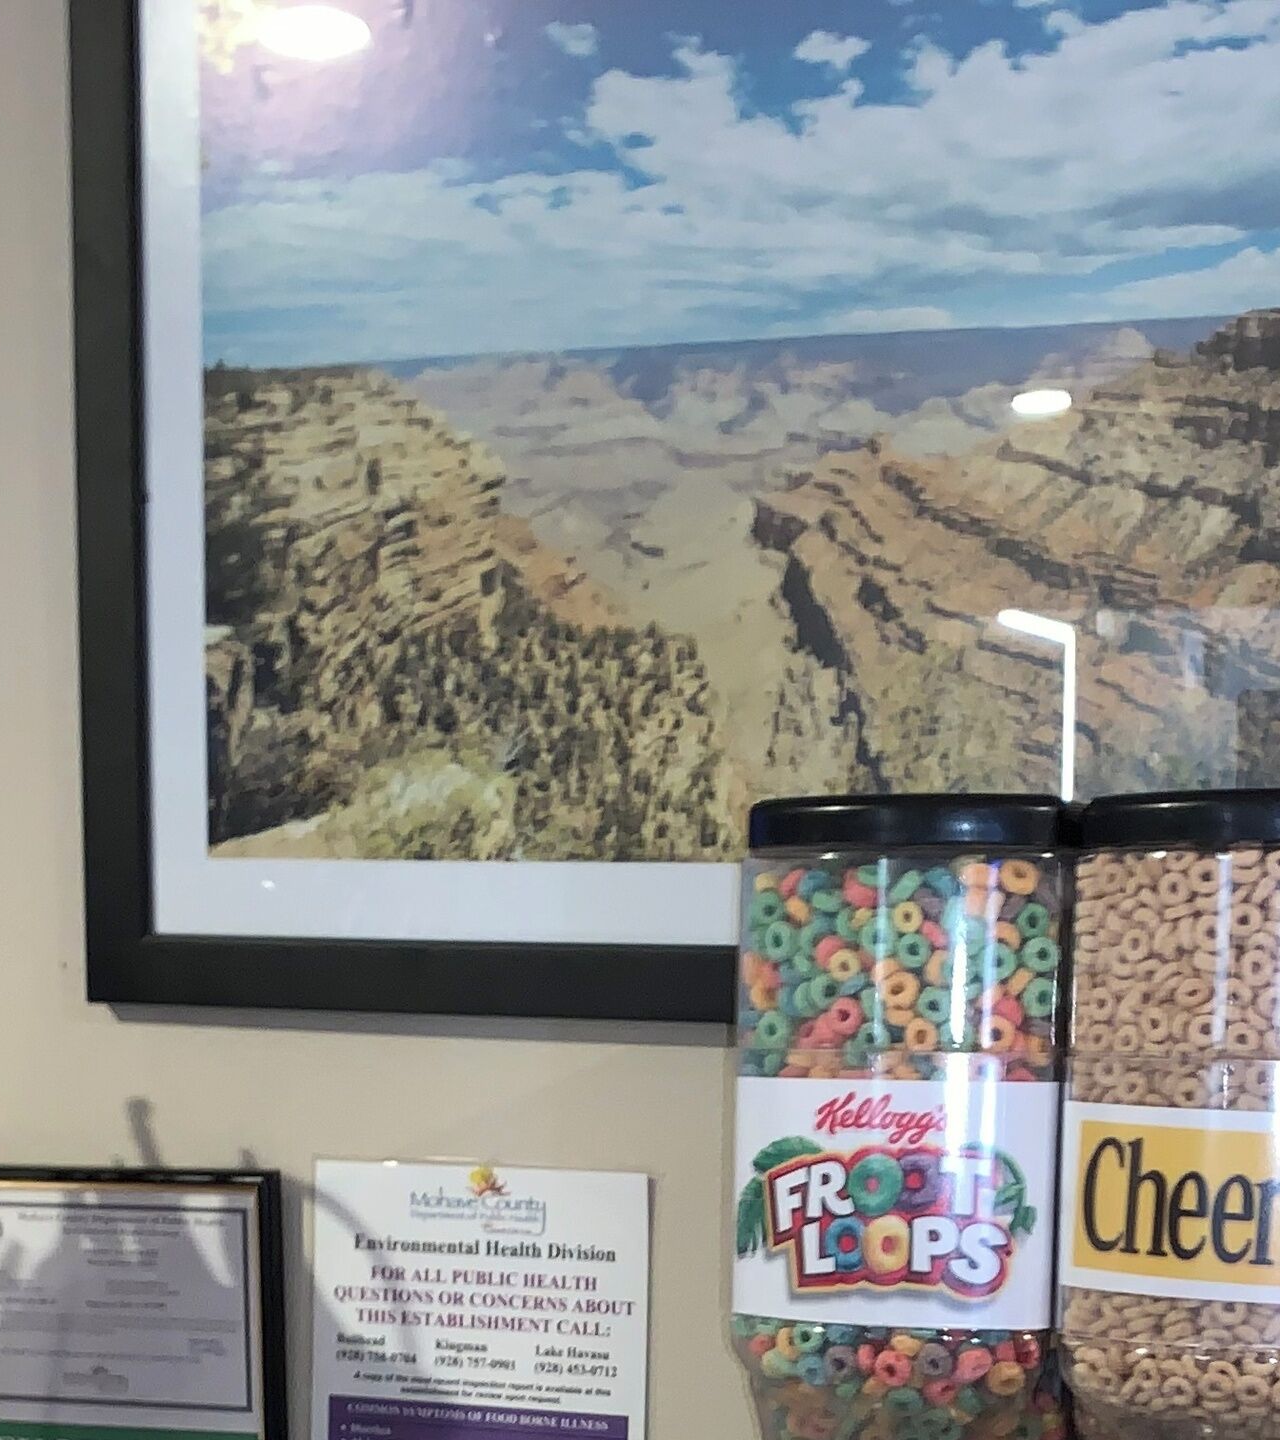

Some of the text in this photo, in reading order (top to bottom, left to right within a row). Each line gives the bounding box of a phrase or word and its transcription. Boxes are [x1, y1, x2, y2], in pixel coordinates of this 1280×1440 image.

[773, 1152, 993, 1234] FROOT
[354, 1233, 616, 1262] Environmental Health Division
[801, 1213, 1009, 1285] LOOPS
[371, 1265, 597, 1291] FOR ALL PUBLIC HEALTH
[334, 1285, 636, 1316] QUESTIONS OR CONCERNS ABOUT
[356, 1307, 611, 1337] THIS ESTABLISHMENT CALL:
[435, 1338, 488, 1353] Kingman
[535, 1344, 563, 1357] Lake
[534, 1362, 617, 1378] (928) 453-0712
[485, 1411, 518, 1424] FOOD
[560, 1417, 609, 1431] ILLNESS
